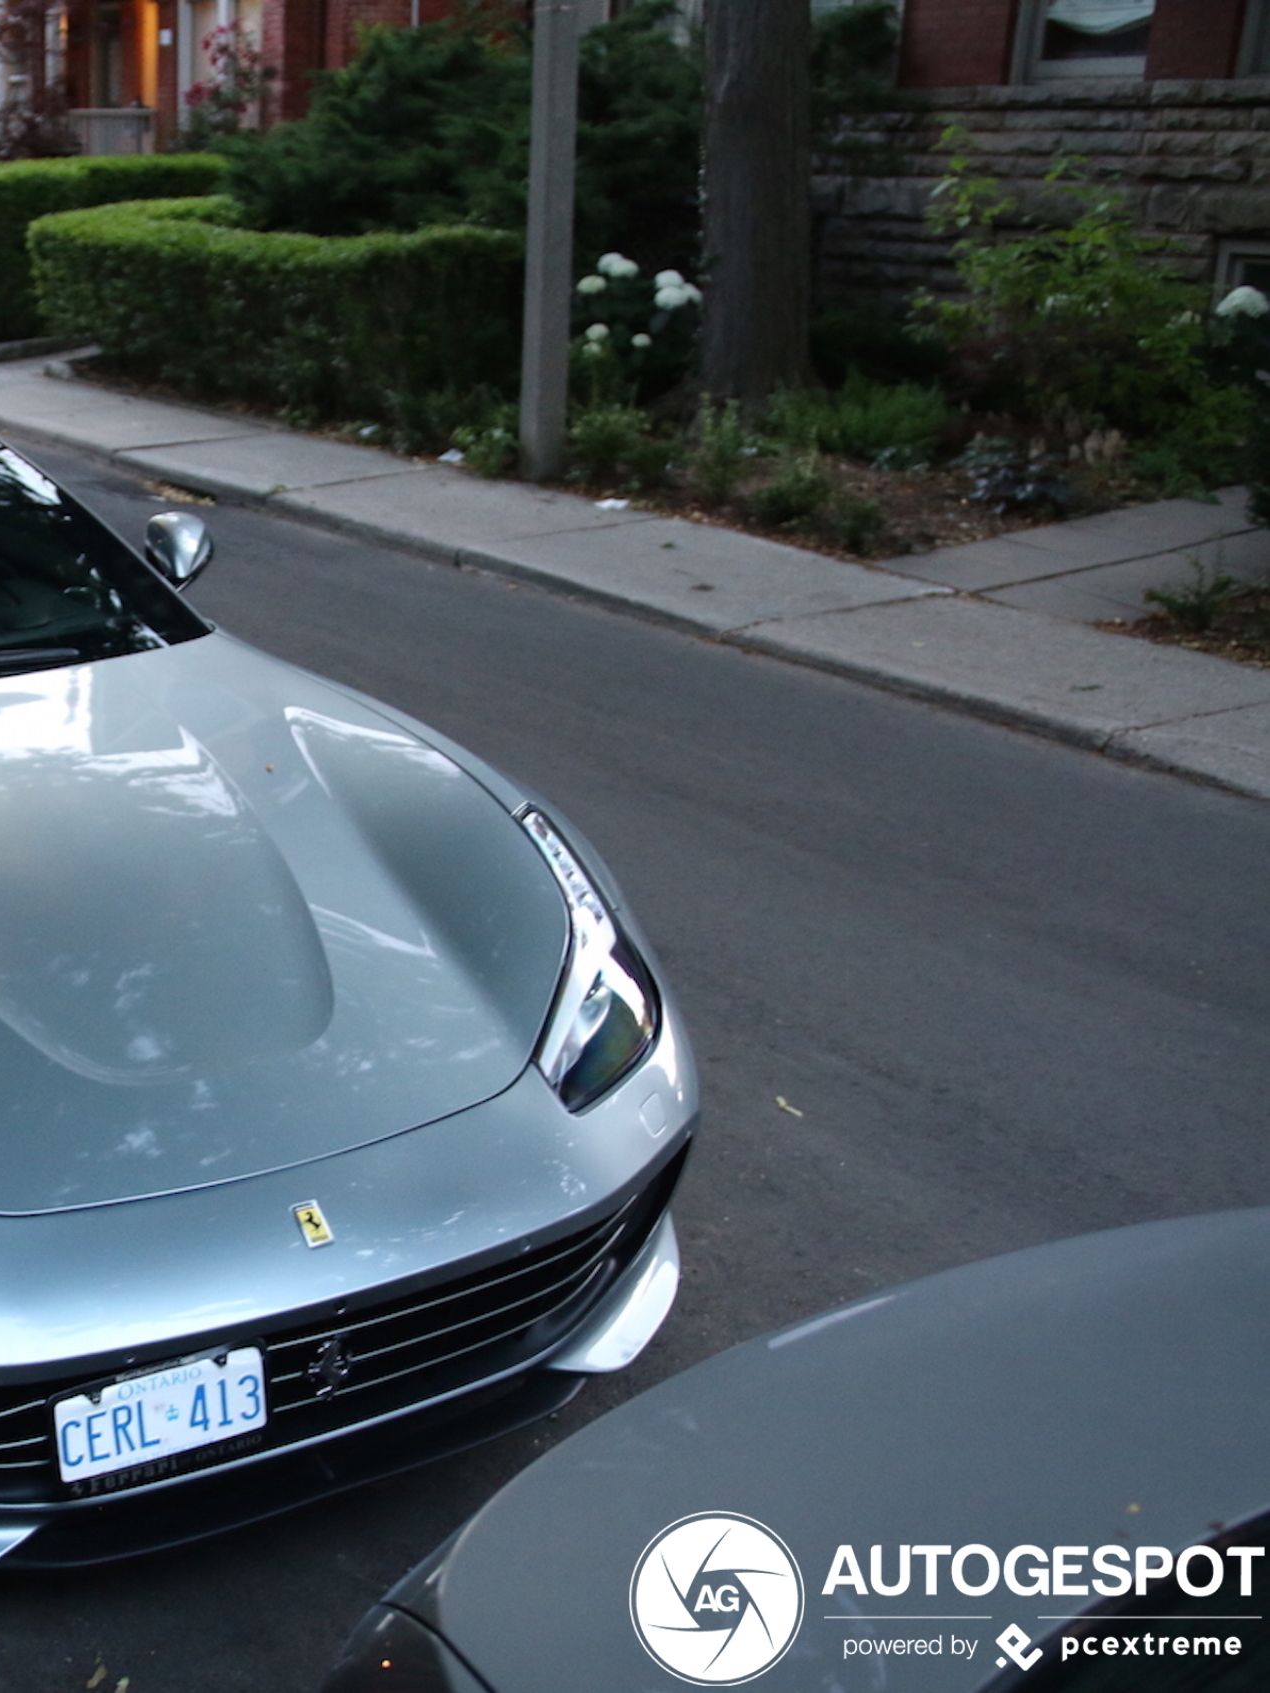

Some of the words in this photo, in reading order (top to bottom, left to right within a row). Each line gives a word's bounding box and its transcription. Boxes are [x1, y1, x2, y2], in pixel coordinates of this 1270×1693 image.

[61, 1400, 160, 1466] CERL
[189, 1374, 261, 1431] 413
[90, 1457, 178, 1494] Ferrari
